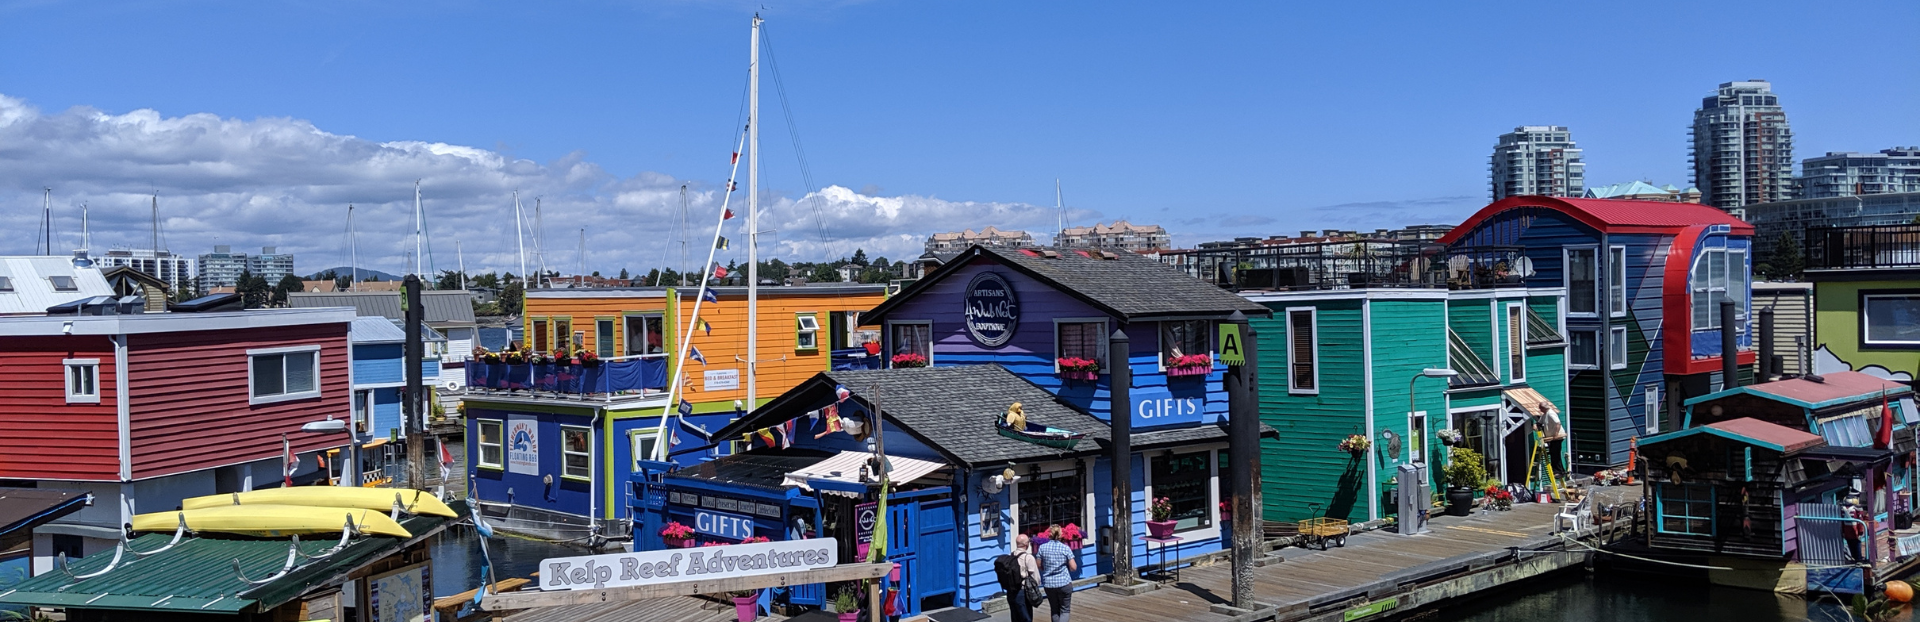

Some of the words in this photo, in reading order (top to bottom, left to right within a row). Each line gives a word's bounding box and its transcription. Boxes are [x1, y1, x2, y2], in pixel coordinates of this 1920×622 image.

[402, 292, 407, 305] B
[974, 289, 1005, 297] ARTISANS
[975, 322, 1006, 331] BOUTIQUE
[1222, 333, 1239, 355] A
[1138, 398, 1196, 419] GIFTS
[697, 512, 752, 539] GIFTS
[549, 559, 612, 589] Kelp
[619, 552, 683, 580] Reef
[686, 549, 830, 575] Adventures
